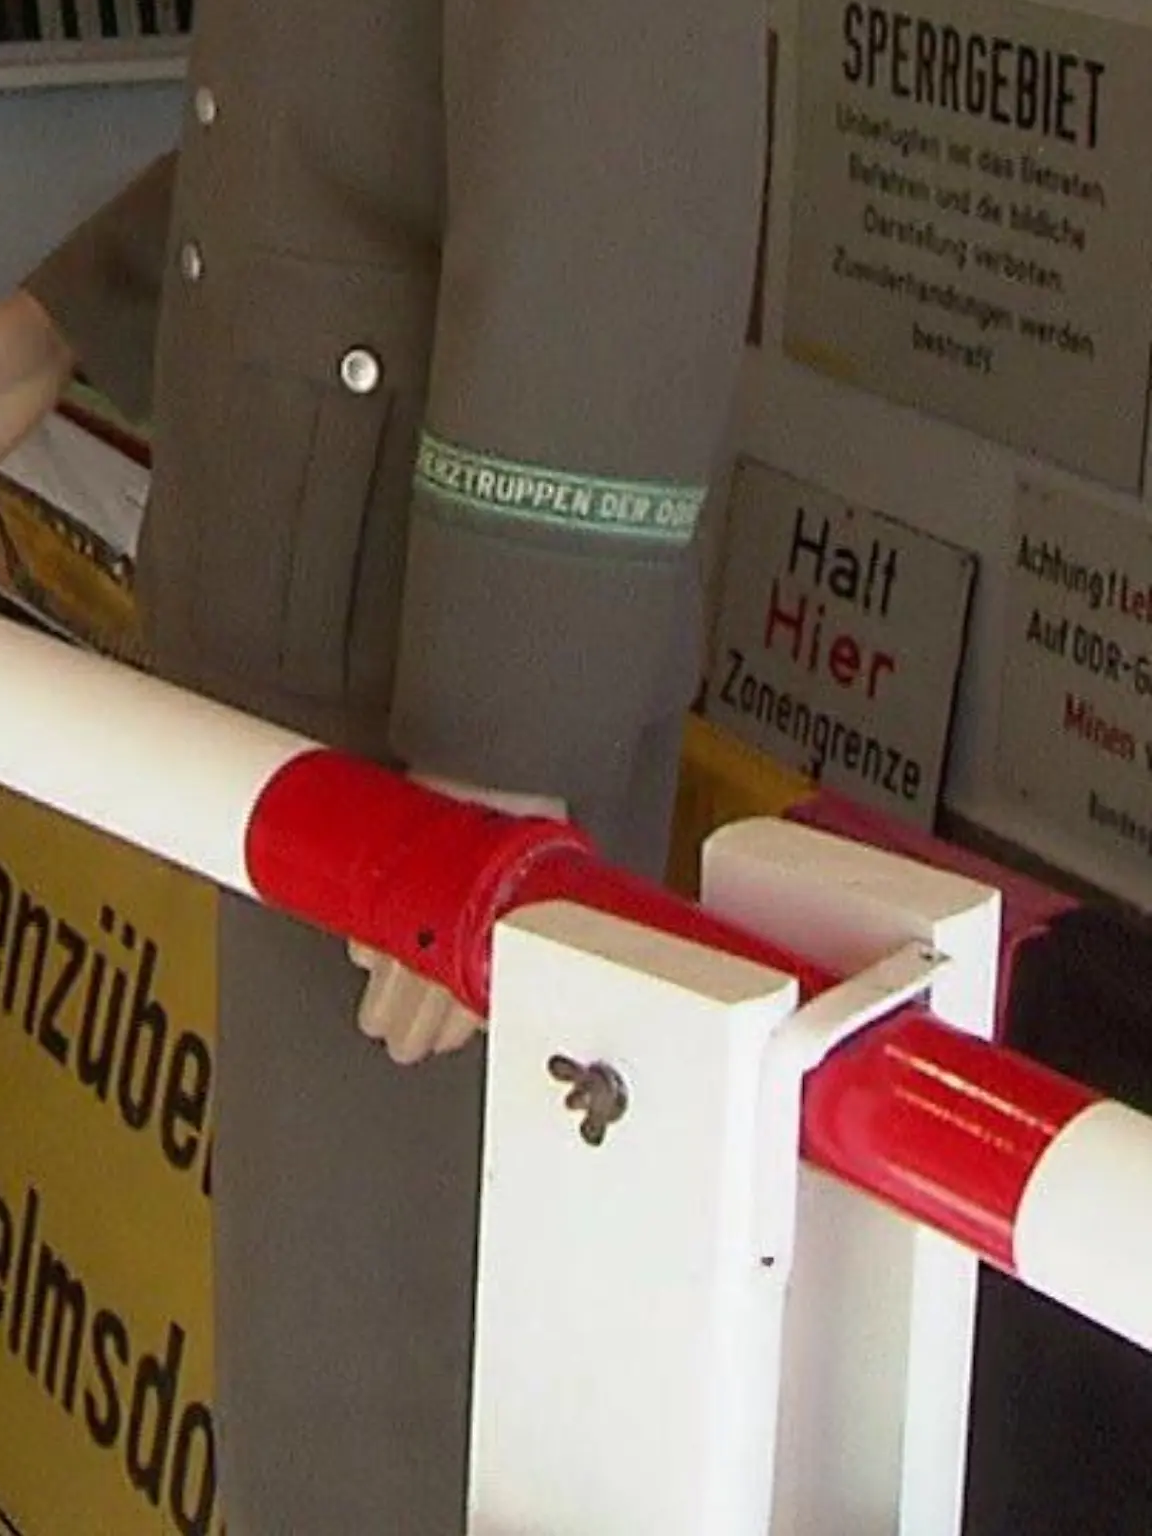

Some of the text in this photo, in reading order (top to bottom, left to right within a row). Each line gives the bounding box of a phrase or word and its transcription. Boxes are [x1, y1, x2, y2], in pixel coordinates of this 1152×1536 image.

[842, 2, 1105, 150] SPERRGEBIET
[787, 507, 898, 617] Halt
[1017, 534, 1116, 612] Achtung!
[763, 578, 897, 699] Hier
[1027, 607, 1152, 696] Auf DDR-G
[719, 648, 923, 801] Zonengrenze
[1063, 691, 1136, 762] Minen
